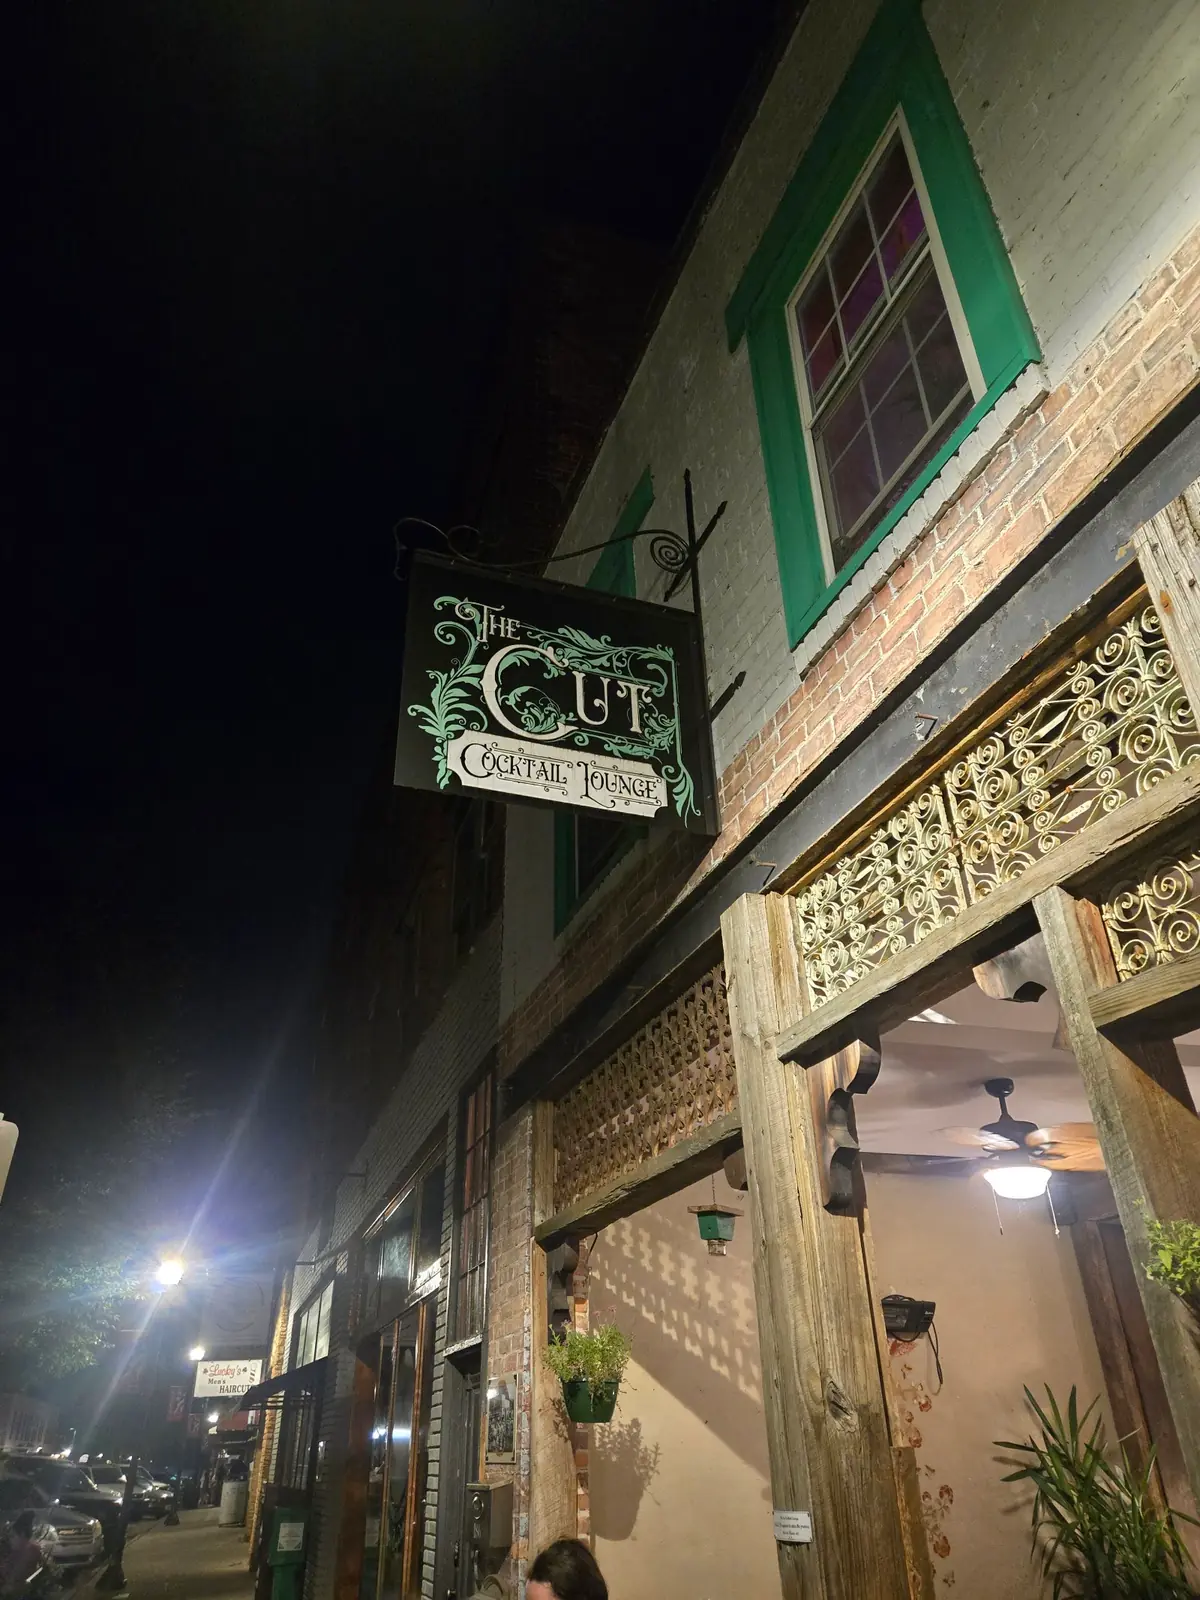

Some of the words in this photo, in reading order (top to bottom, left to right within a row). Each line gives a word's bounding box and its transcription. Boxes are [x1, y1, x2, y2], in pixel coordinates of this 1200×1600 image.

[455, 600, 521, 643] THE
[480, 643, 653, 741] CUT
[460, 743, 568, 785] COCKTAIL
[577, 761, 658, 808] LOUNGE
[208, 1364, 242, 1379] Lucky's
